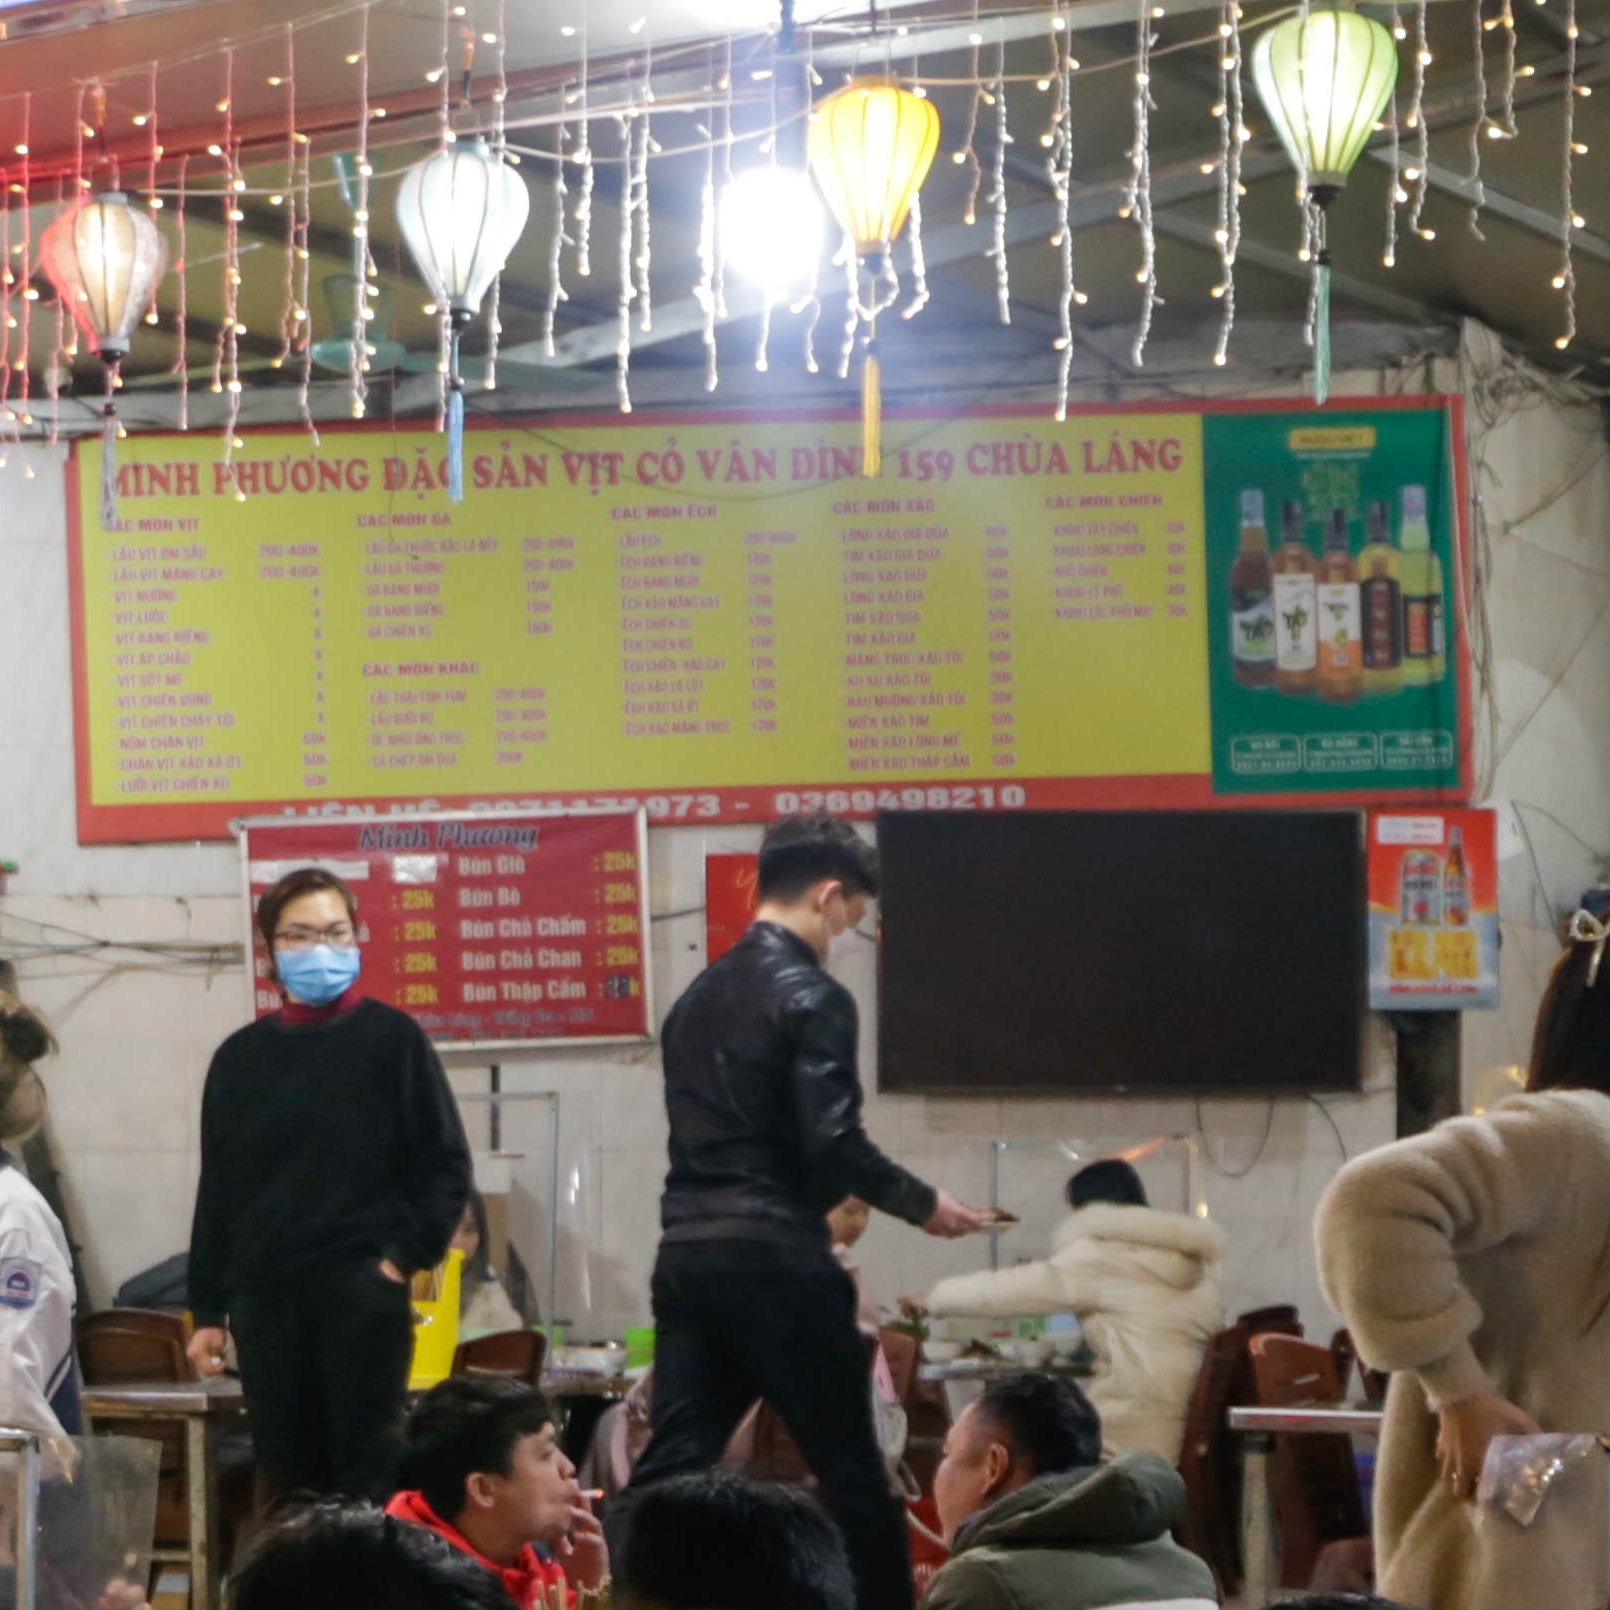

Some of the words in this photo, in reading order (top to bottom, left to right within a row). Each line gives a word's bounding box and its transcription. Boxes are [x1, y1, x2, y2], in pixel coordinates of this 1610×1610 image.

[213, 451, 370, 496] PHƯƠNG
[473, 441, 549, 489] SẢN
[560, 451, 625, 496] VỊT
[637, 437, 685, 484] CỎ
[697, 442, 778, 483] VÂN
[898, 449, 955, 484] 159
[967, 432, 1071, 477] CHÙA
[1082, 429, 1184, 474] LÁNG
[775, 785, 1027, 814] 0369498210
[359, 822, 429, 851] Minh
[458, 855, 492, 876] Bún
[603, 851, 636, 873] 25k
[402, 888, 435, 909] 25k
[459, 886, 493, 908] Bún
[603, 882, 637, 903] 25k
[404, 920, 437, 941] 25k
[461, 917, 495, 939] Bún
[606, 914, 638, 935] 25k
[405, 952, 438, 973] 25k
[461, 948, 496, 970] Bún
[537, 949, 582, 969] Chan
[607, 945, 638, 966] 25k
[405, 983, 438, 1005] 25k
[462, 980, 496, 1003] Bún
